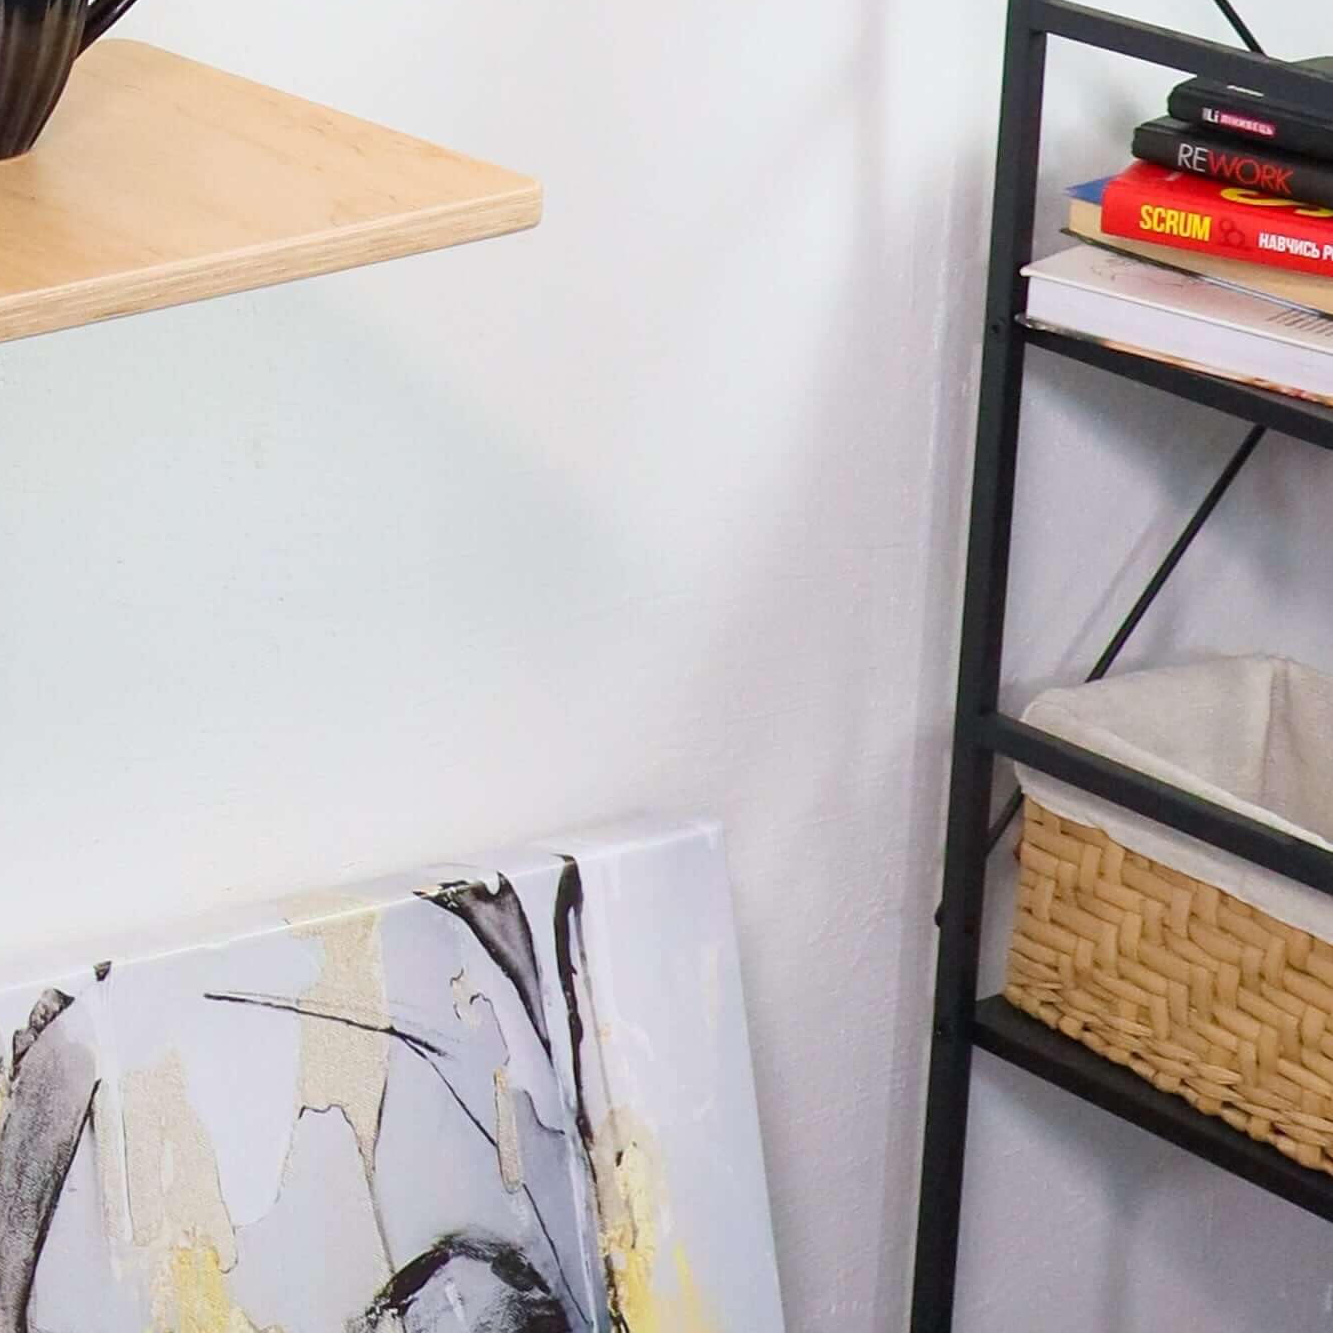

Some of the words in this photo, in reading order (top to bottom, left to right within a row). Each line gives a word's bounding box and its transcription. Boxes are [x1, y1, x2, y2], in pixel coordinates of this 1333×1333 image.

[1177, 142, 1294, 195] REWORK
[1139, 204, 1213, 242] SCRUM
[1258, 232, 1321, 259] НАВЧИСЬ
[1322, 244, 1333, 262] Р
